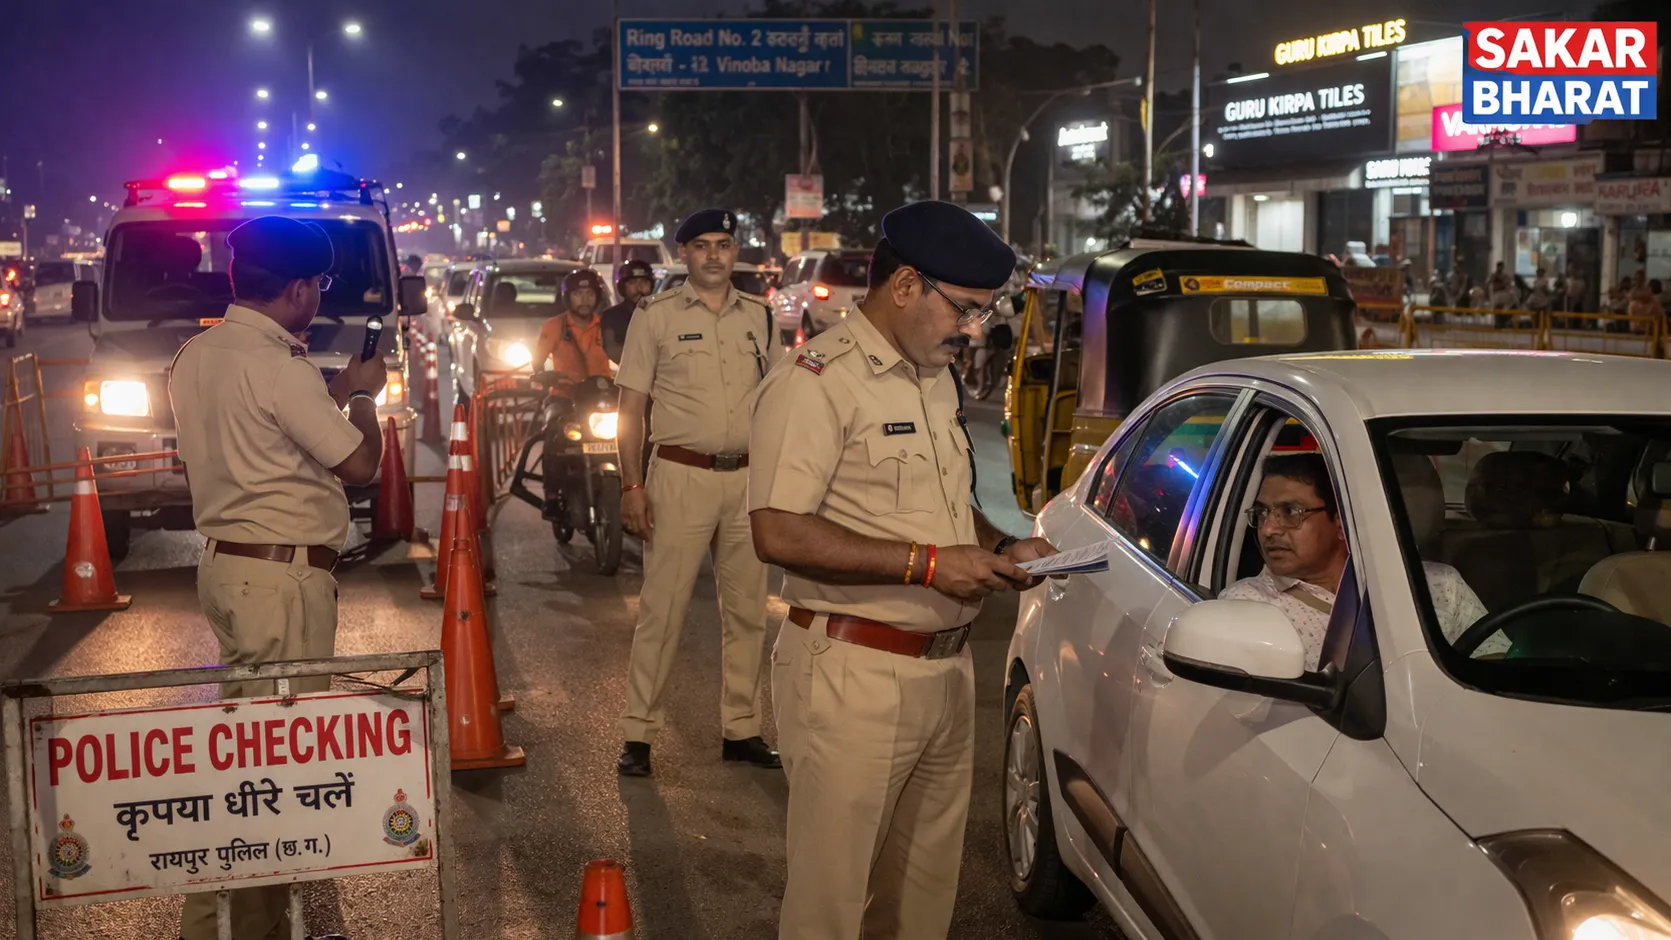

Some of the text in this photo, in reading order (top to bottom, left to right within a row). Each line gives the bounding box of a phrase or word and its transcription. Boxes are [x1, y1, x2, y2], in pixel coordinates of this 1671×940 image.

[626, 29, 665, 50] Ring
[670, 29, 714, 46] Road
[718, 29, 746, 46] No.
[751, 30, 762, 46] 2
[1274, 18, 1406, 65] GURU KIRPA TILES
[716, 56, 771, 73] Vinoba
[775, 56, 822, 77] Nagar
[1225, 83, 1365, 121] GURU KIRPA TILES
[1223, 279, 1292, 291] Compact
[48, 708, 412, 787] POLICE CHECKING
[113, 771, 355, 841] कृपया धीरे चलें
[149, 848, 210, 874] रायपुर
